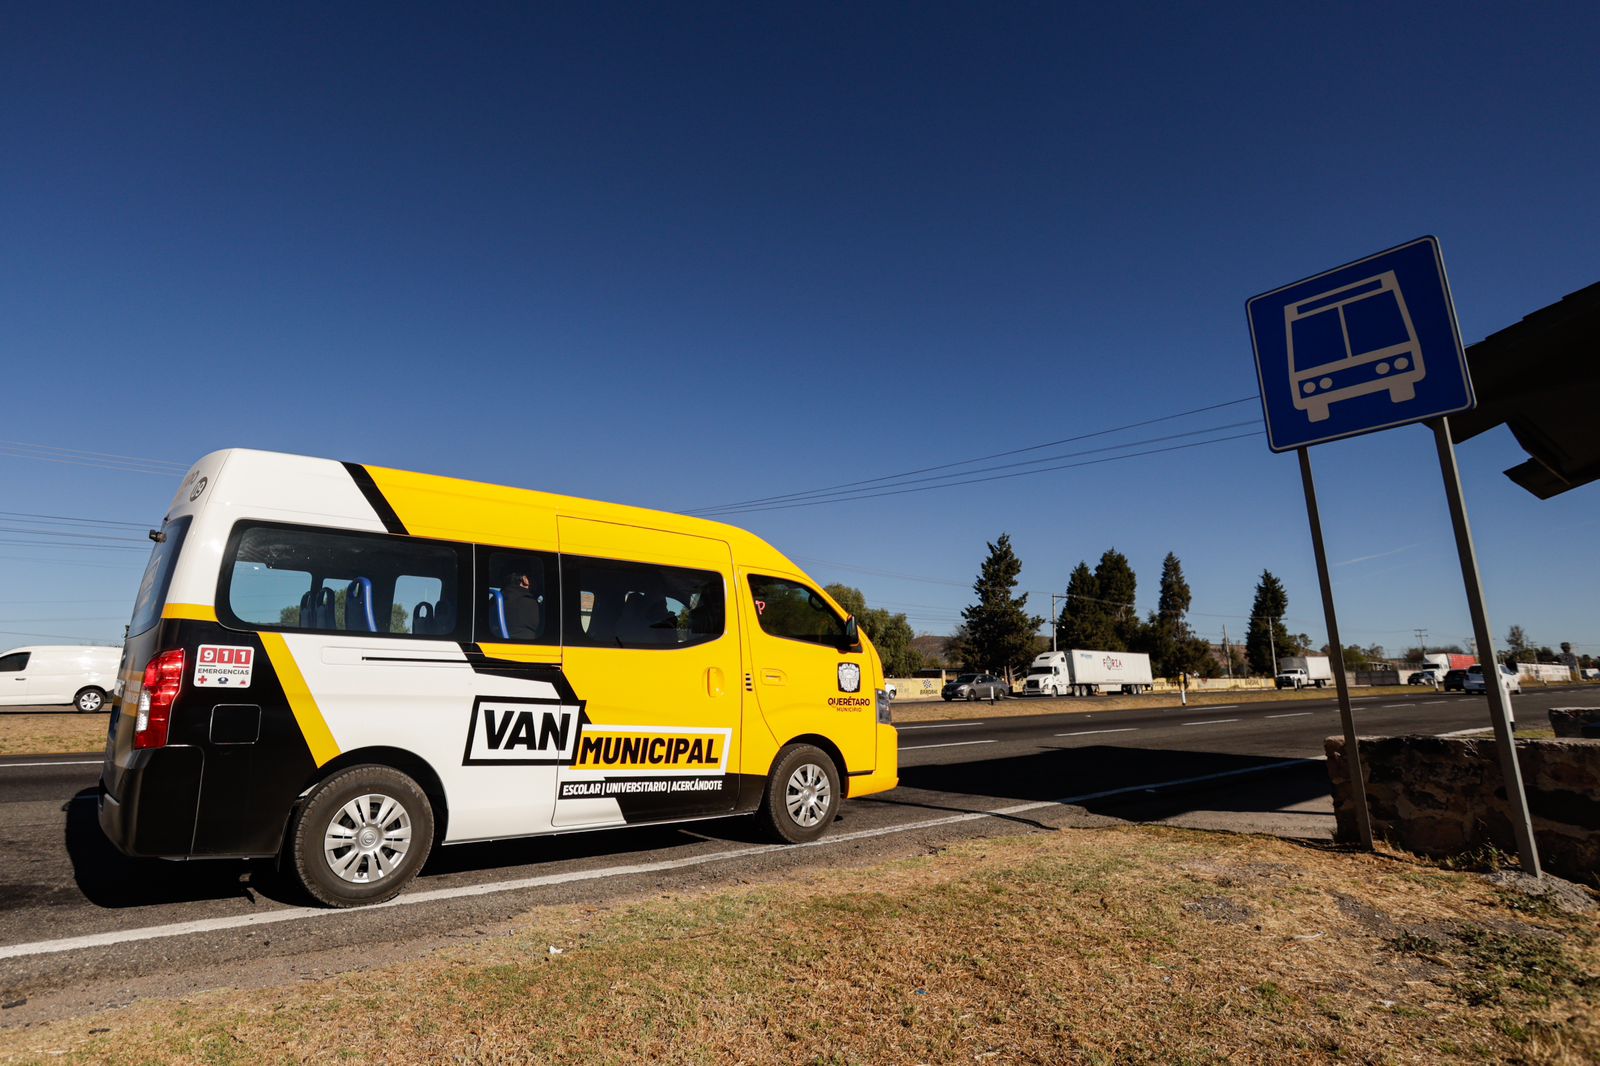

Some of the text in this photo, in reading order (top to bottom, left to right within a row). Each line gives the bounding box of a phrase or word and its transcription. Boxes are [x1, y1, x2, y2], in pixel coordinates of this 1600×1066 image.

[203, 649, 247, 663] 911
[197, 668, 250, 676] EMERGENCIAS
[828, 696, 871, 706] QUERÉTARO
[483, 709, 572, 751] VAN
[579, 736, 719, 765] MUNICIPAL
[562, 778, 723, 796] ESCOLAR UNIVERSITARIO ACERCÁNDOTE
